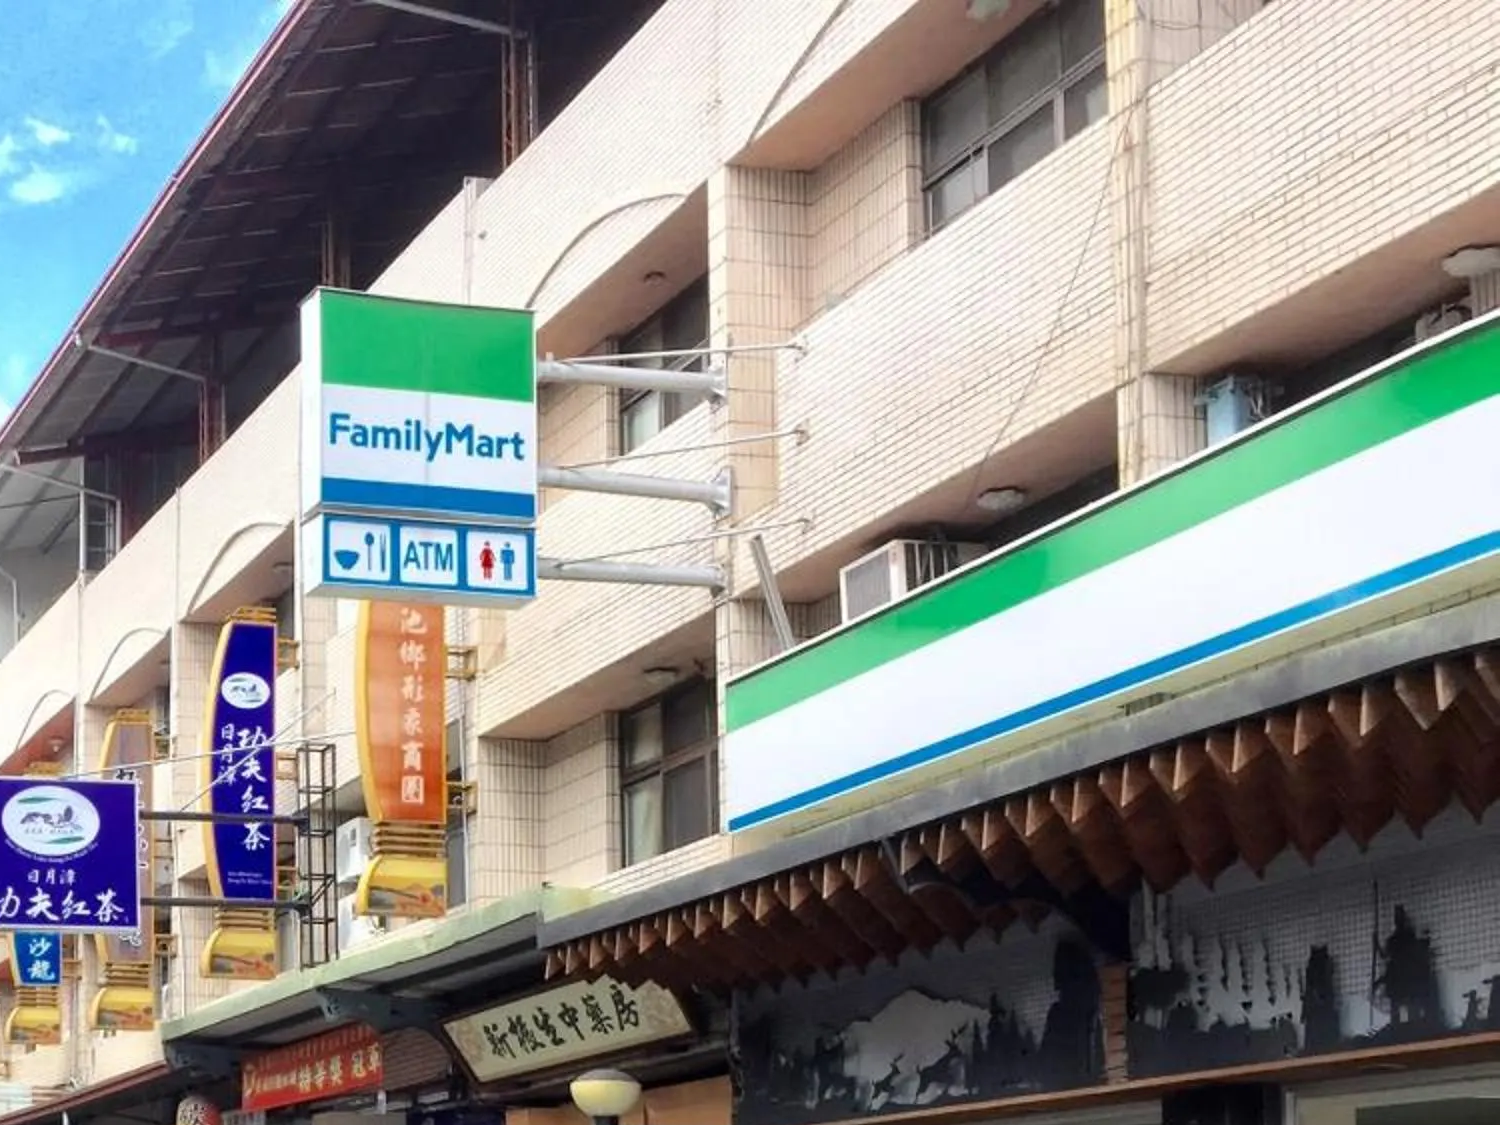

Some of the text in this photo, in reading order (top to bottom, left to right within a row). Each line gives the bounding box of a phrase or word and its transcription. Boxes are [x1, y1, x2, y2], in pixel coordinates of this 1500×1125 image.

[328, 412, 526, 462] FamilyMart
[402, 540, 454, 573] ATM
[237, 726, 271, 851] 功夫紅茶
